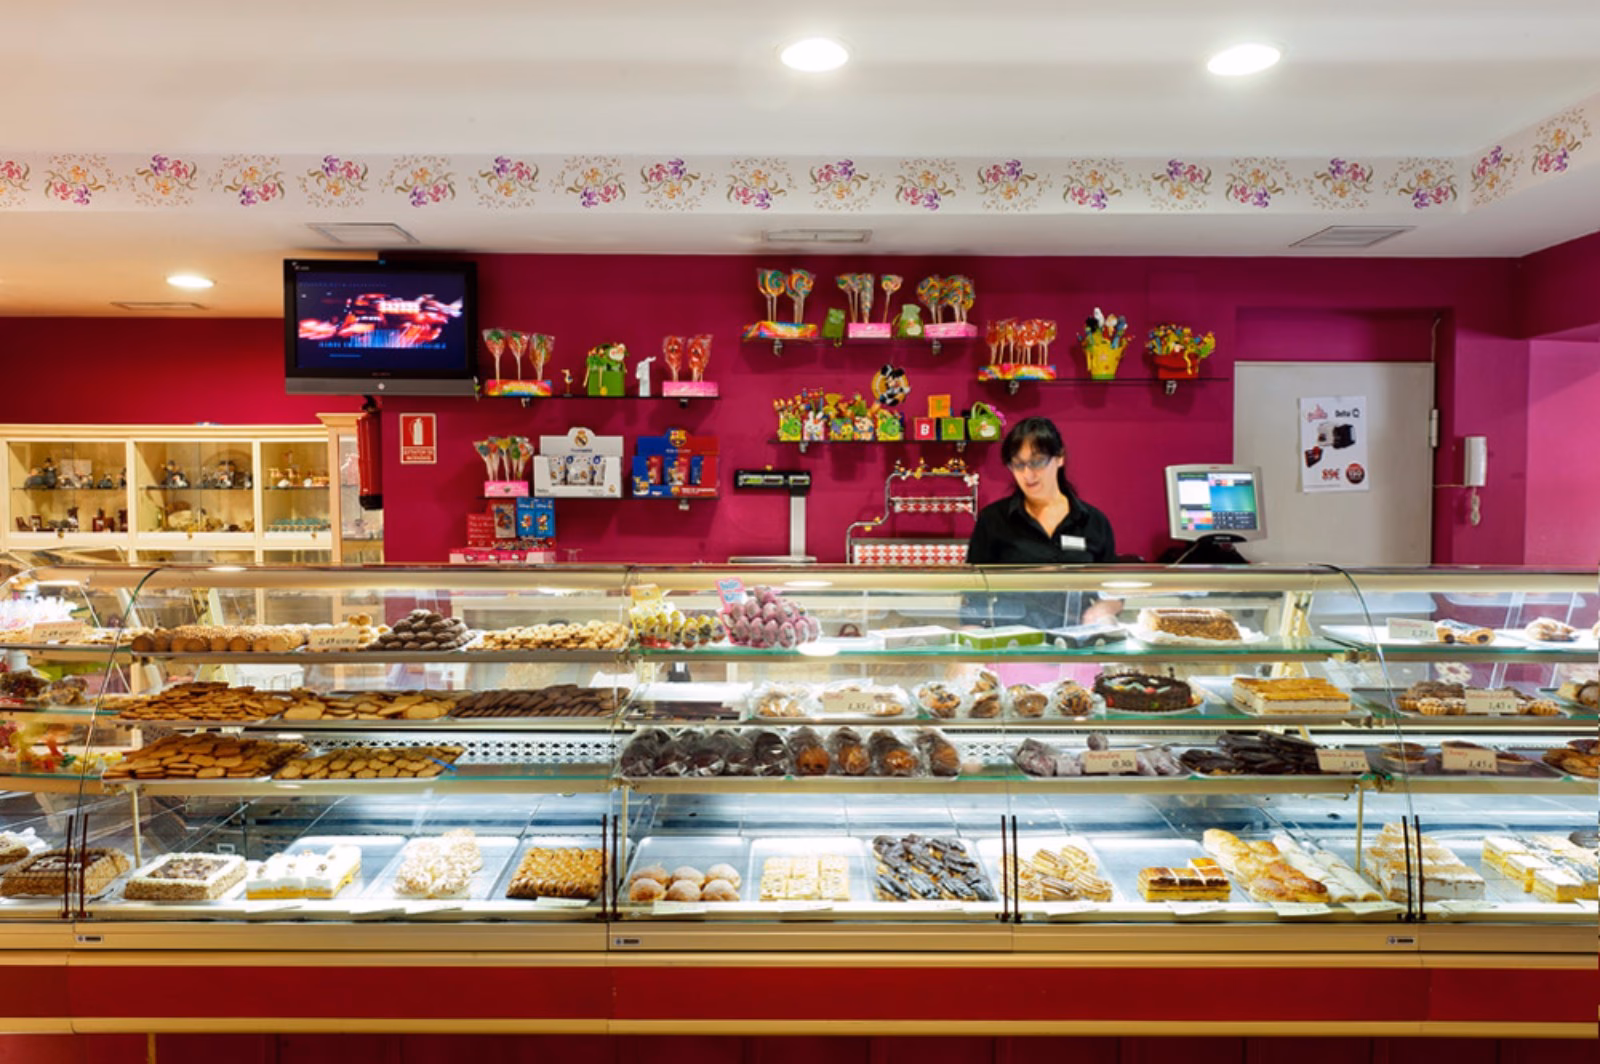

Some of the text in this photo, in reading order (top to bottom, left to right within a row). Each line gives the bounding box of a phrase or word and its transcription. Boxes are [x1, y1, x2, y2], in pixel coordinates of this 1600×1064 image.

[1352, 407, 1361, 418] Q
[921, 423, 930, 436] B
[948, 423, 957, 434] A
